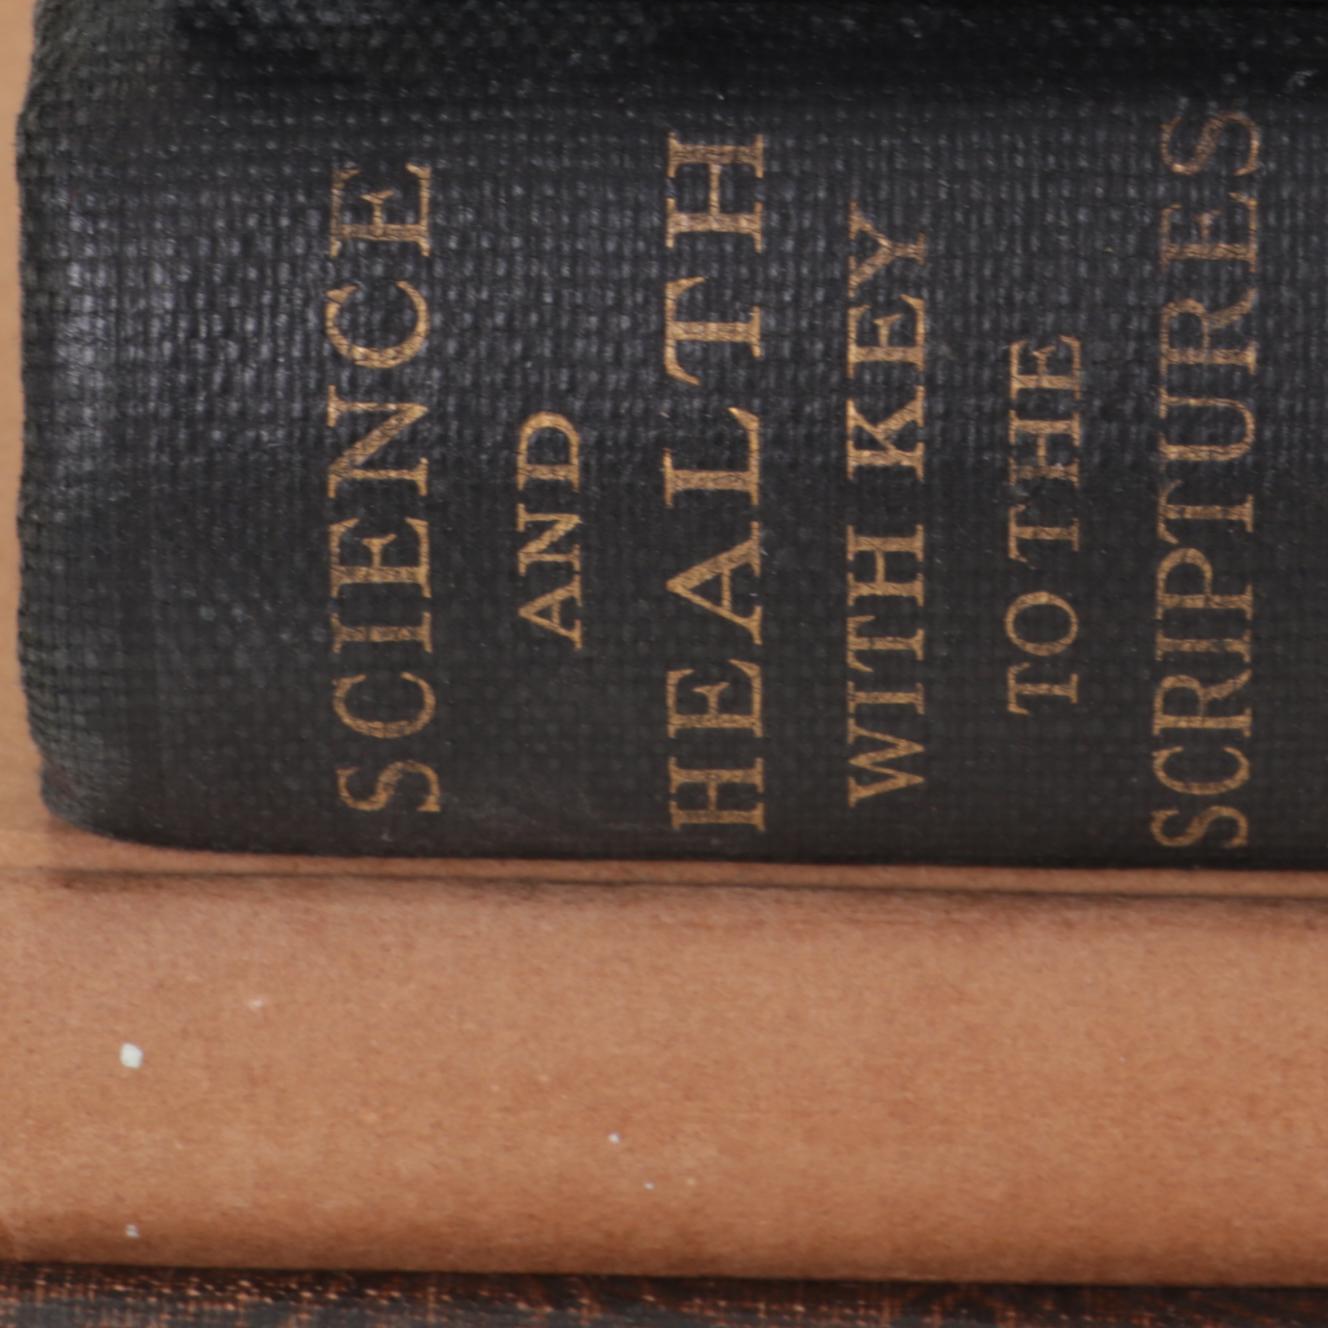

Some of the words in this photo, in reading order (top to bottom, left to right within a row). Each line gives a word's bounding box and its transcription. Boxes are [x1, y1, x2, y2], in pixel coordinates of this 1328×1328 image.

[664, 130, 766, 833] HEALTH
[846, 200, 927, 483] KEY
[1007, 334, 1083, 564] THE
[1149, 108, 1260, 850] SCRIPTURES
[325, 161, 441, 815] SCIENCE
[516, 410, 583, 651] AND
[846, 523, 926, 809] WITH
[1004, 590, 1080, 716] TO
